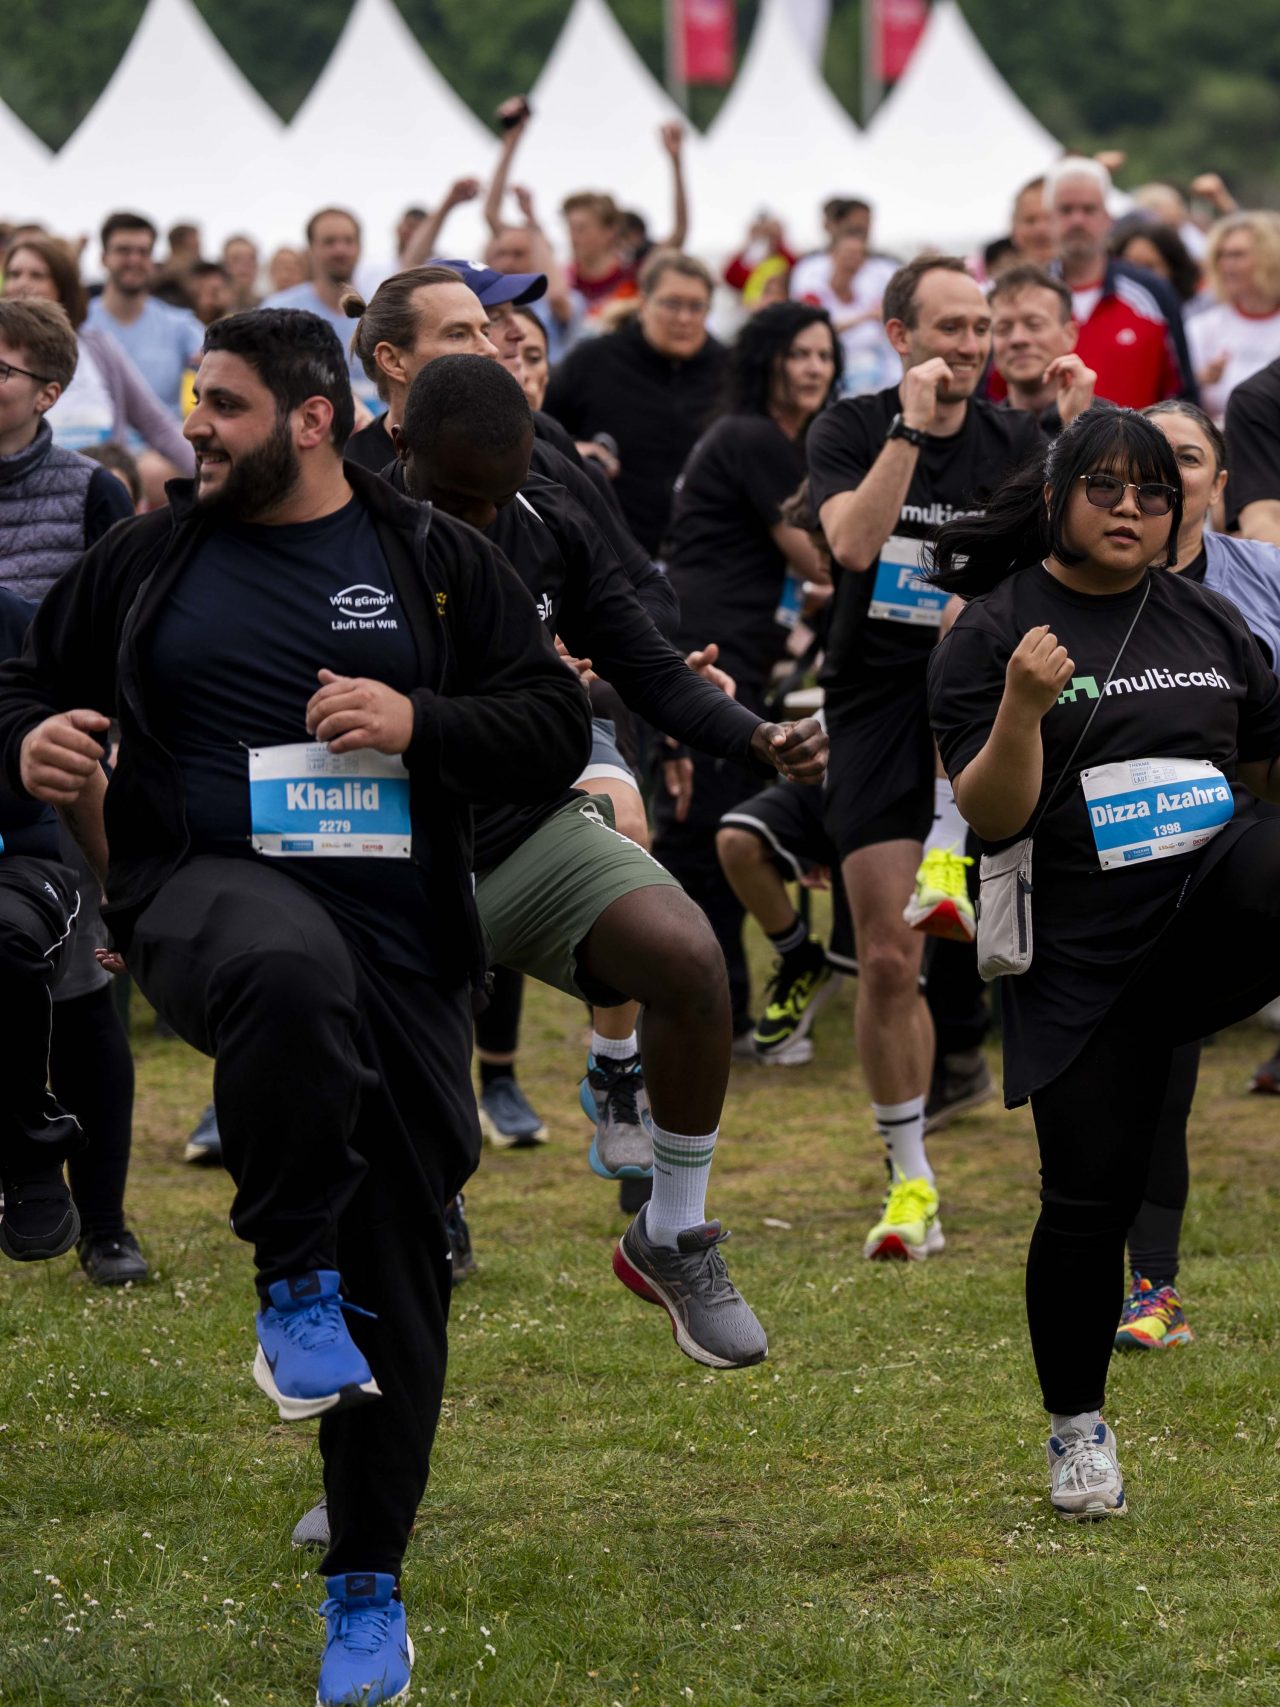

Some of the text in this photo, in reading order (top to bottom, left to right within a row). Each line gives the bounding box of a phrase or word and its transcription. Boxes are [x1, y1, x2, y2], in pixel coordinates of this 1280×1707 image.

[330, 594, 393, 607] WIR gGmbH
[332, 619, 397, 630] Läuft bei WIR
[1104, 667, 1231, 696] multicash
[286, 782, 379, 810] Khalid
[1091, 787, 1229, 827] Dizza Azahra
[319, 820, 351, 832] 2279
[1153, 822, 1181, 837] 1398
